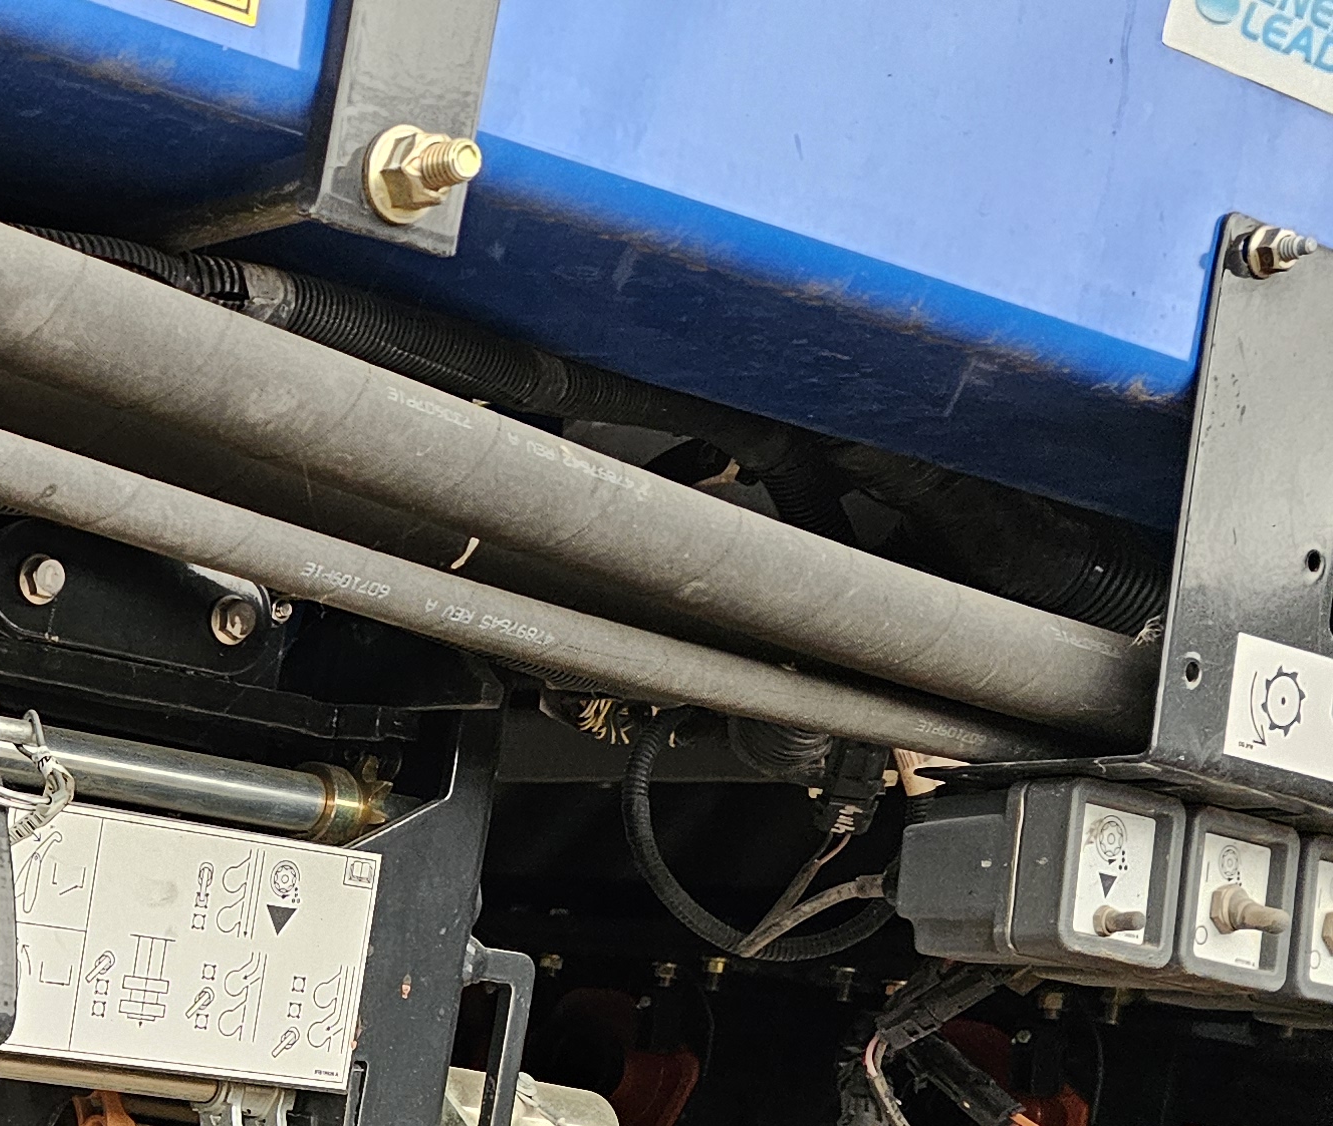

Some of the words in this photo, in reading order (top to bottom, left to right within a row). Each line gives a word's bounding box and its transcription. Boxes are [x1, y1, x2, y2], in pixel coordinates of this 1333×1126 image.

[301, 561, 392, 600] 607109P1E
[424, 598, 439, 614] A
[440, 604, 474, 625] REV
[478, 614, 556, 646] 47897645
